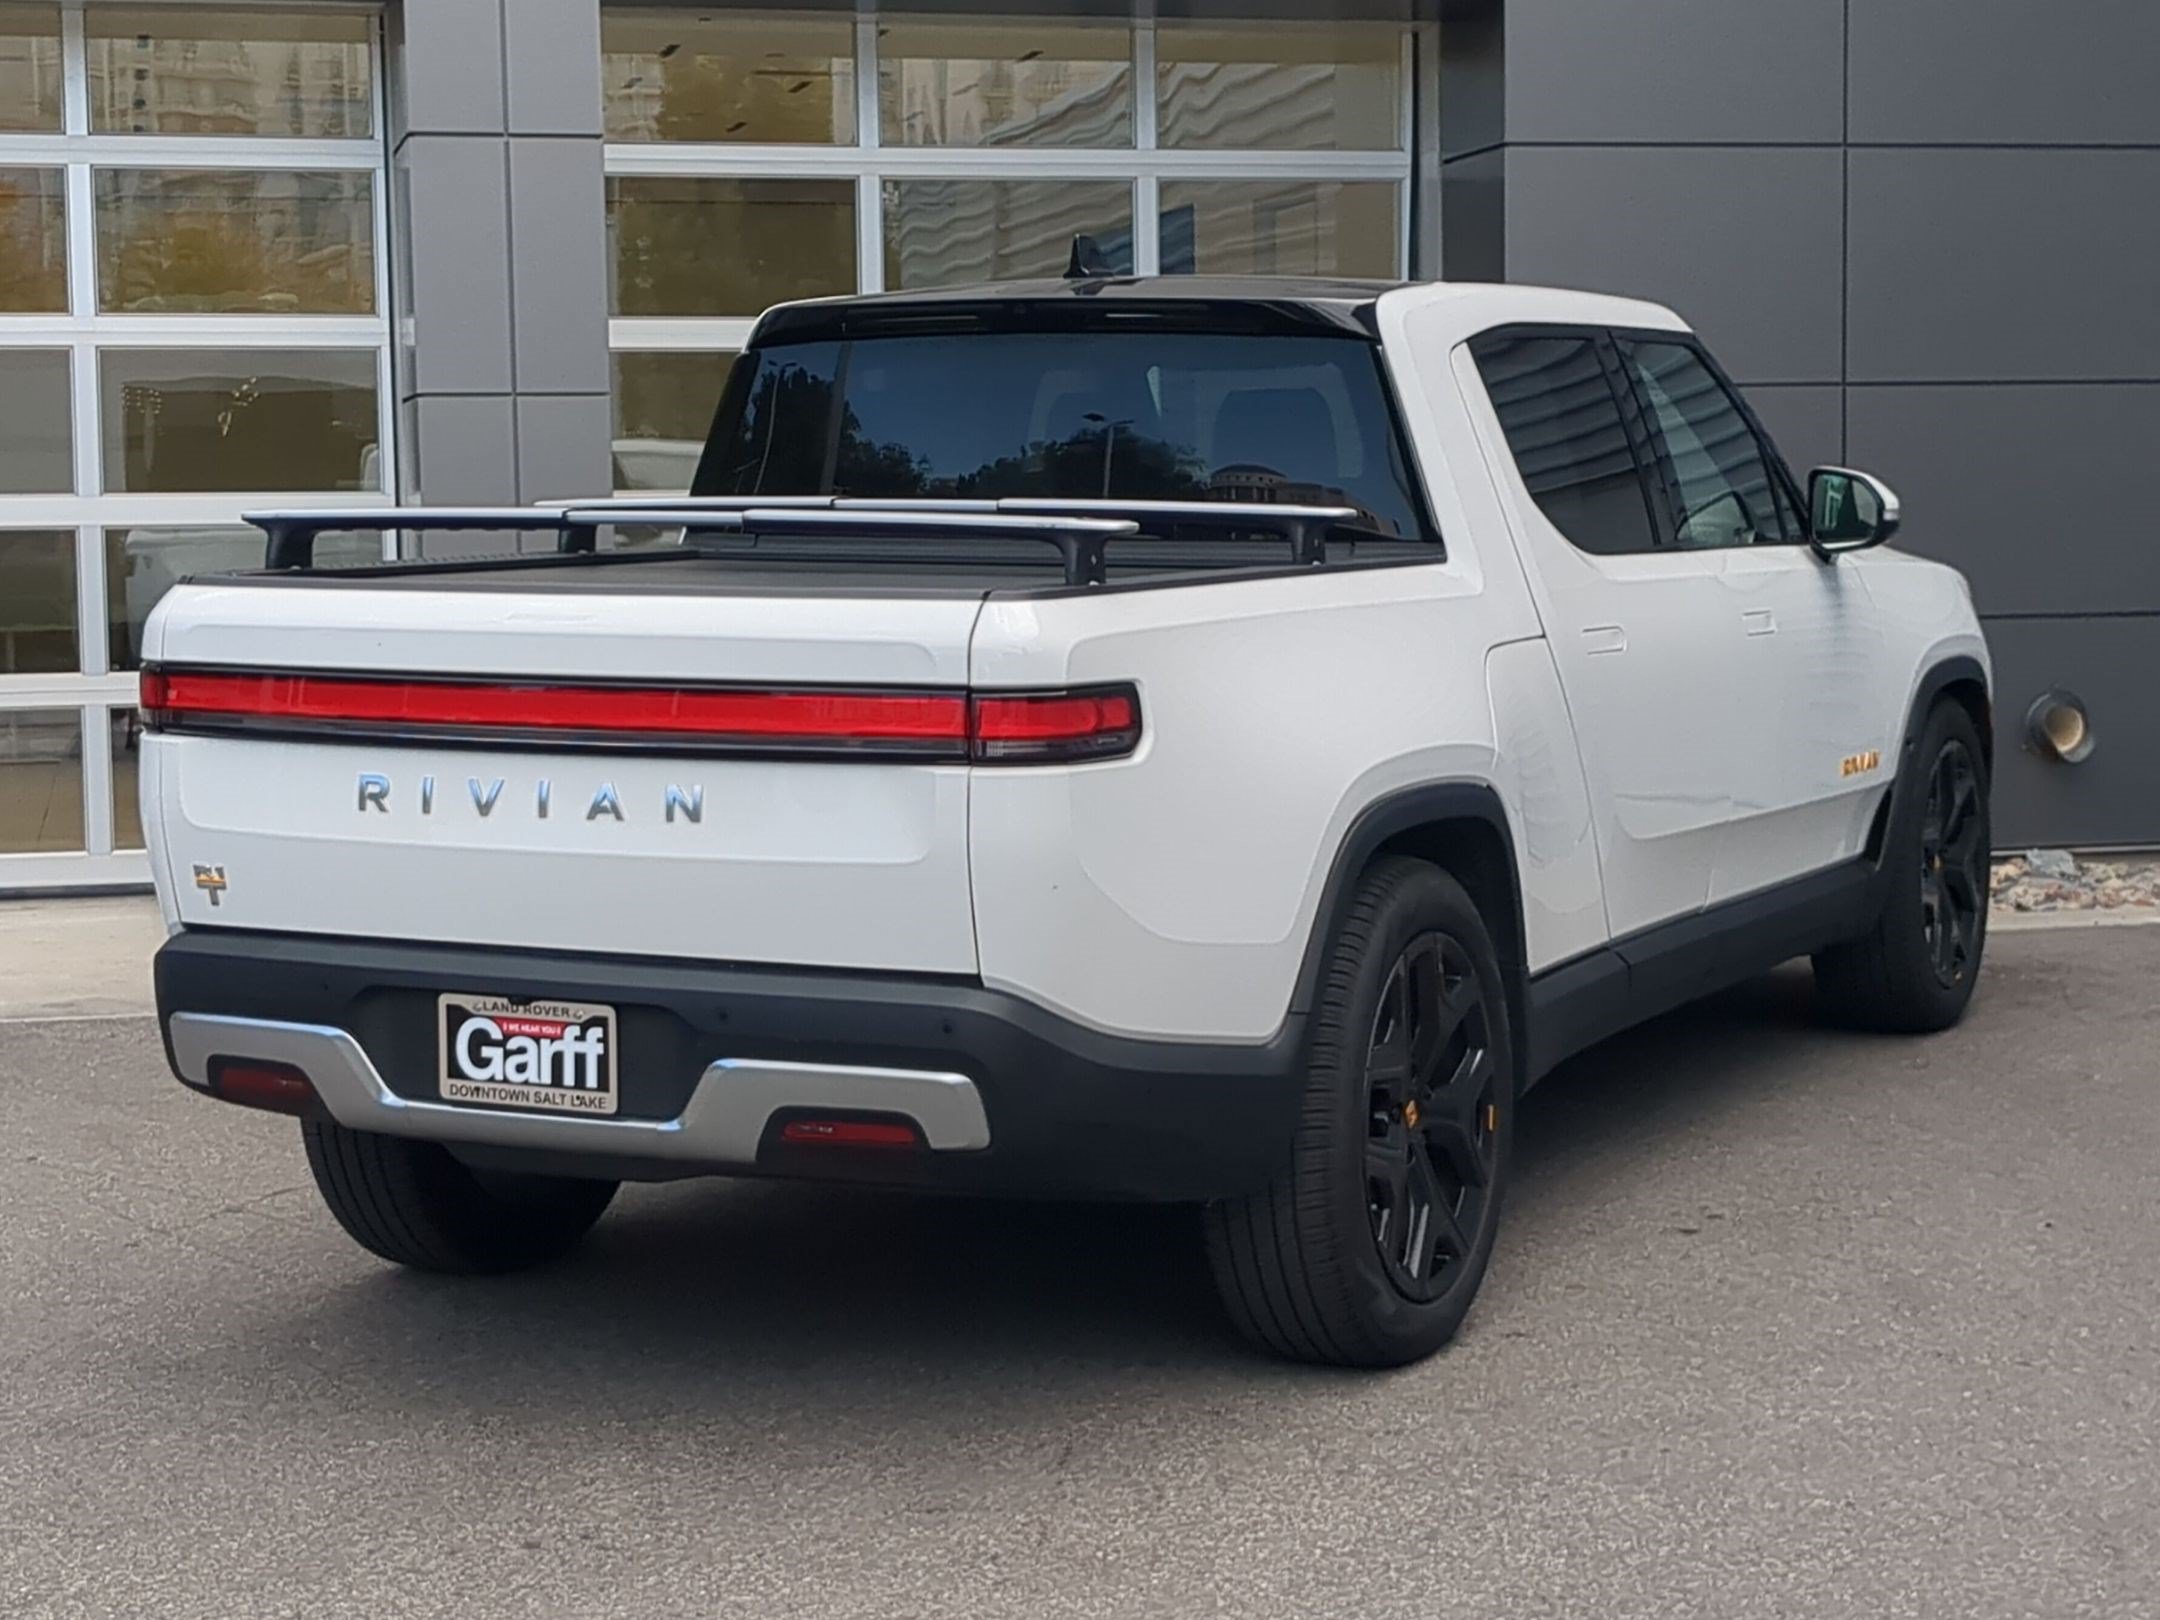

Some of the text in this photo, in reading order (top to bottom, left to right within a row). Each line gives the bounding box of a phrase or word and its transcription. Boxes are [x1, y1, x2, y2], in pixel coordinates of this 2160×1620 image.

[358, 773, 704, 823] RIVIAN
[483, 1001, 570, 1018] LAND ROVER
[456, 1017, 604, 1089] Garff
[450, 1084, 607, 1110] DOWNTOWN SALT LAKE
